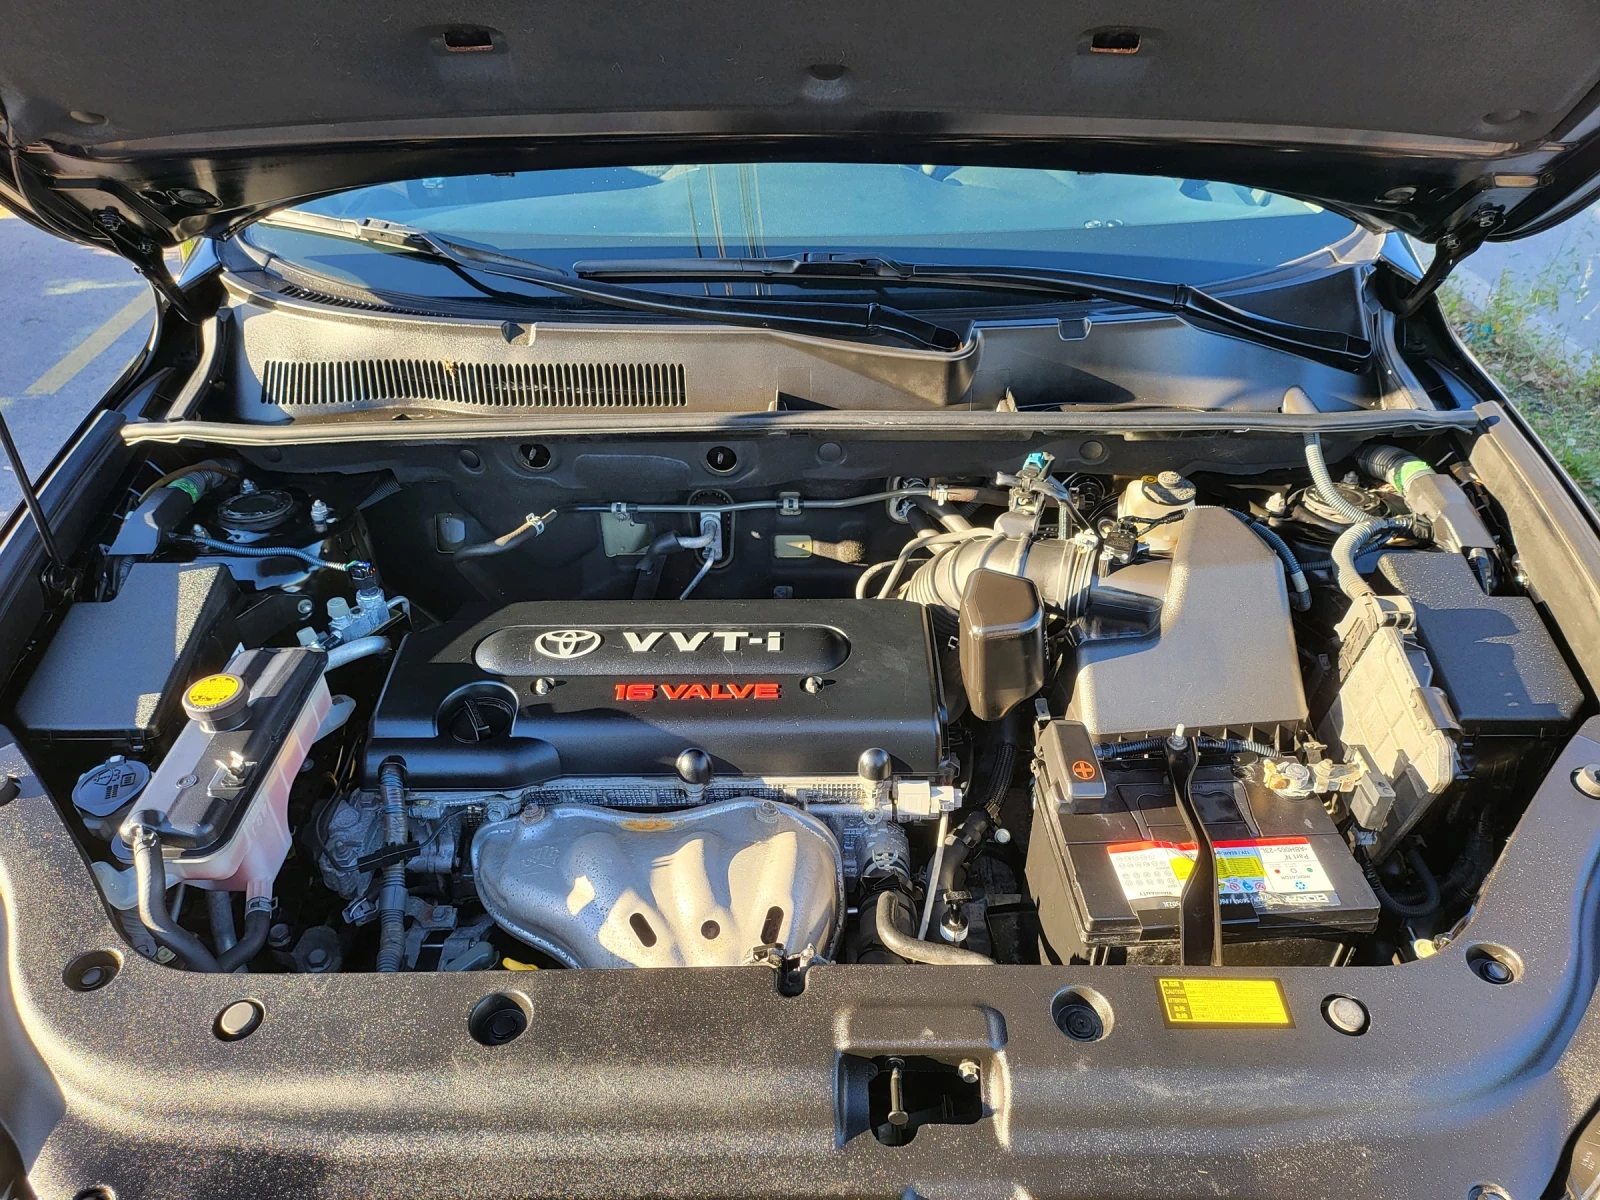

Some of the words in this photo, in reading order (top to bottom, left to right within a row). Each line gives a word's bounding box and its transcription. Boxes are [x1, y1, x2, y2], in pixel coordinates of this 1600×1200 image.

[622, 631, 783, 652] VVT-i
[614, 683, 656, 701] 16
[660, 683, 781, 700] VALVE
